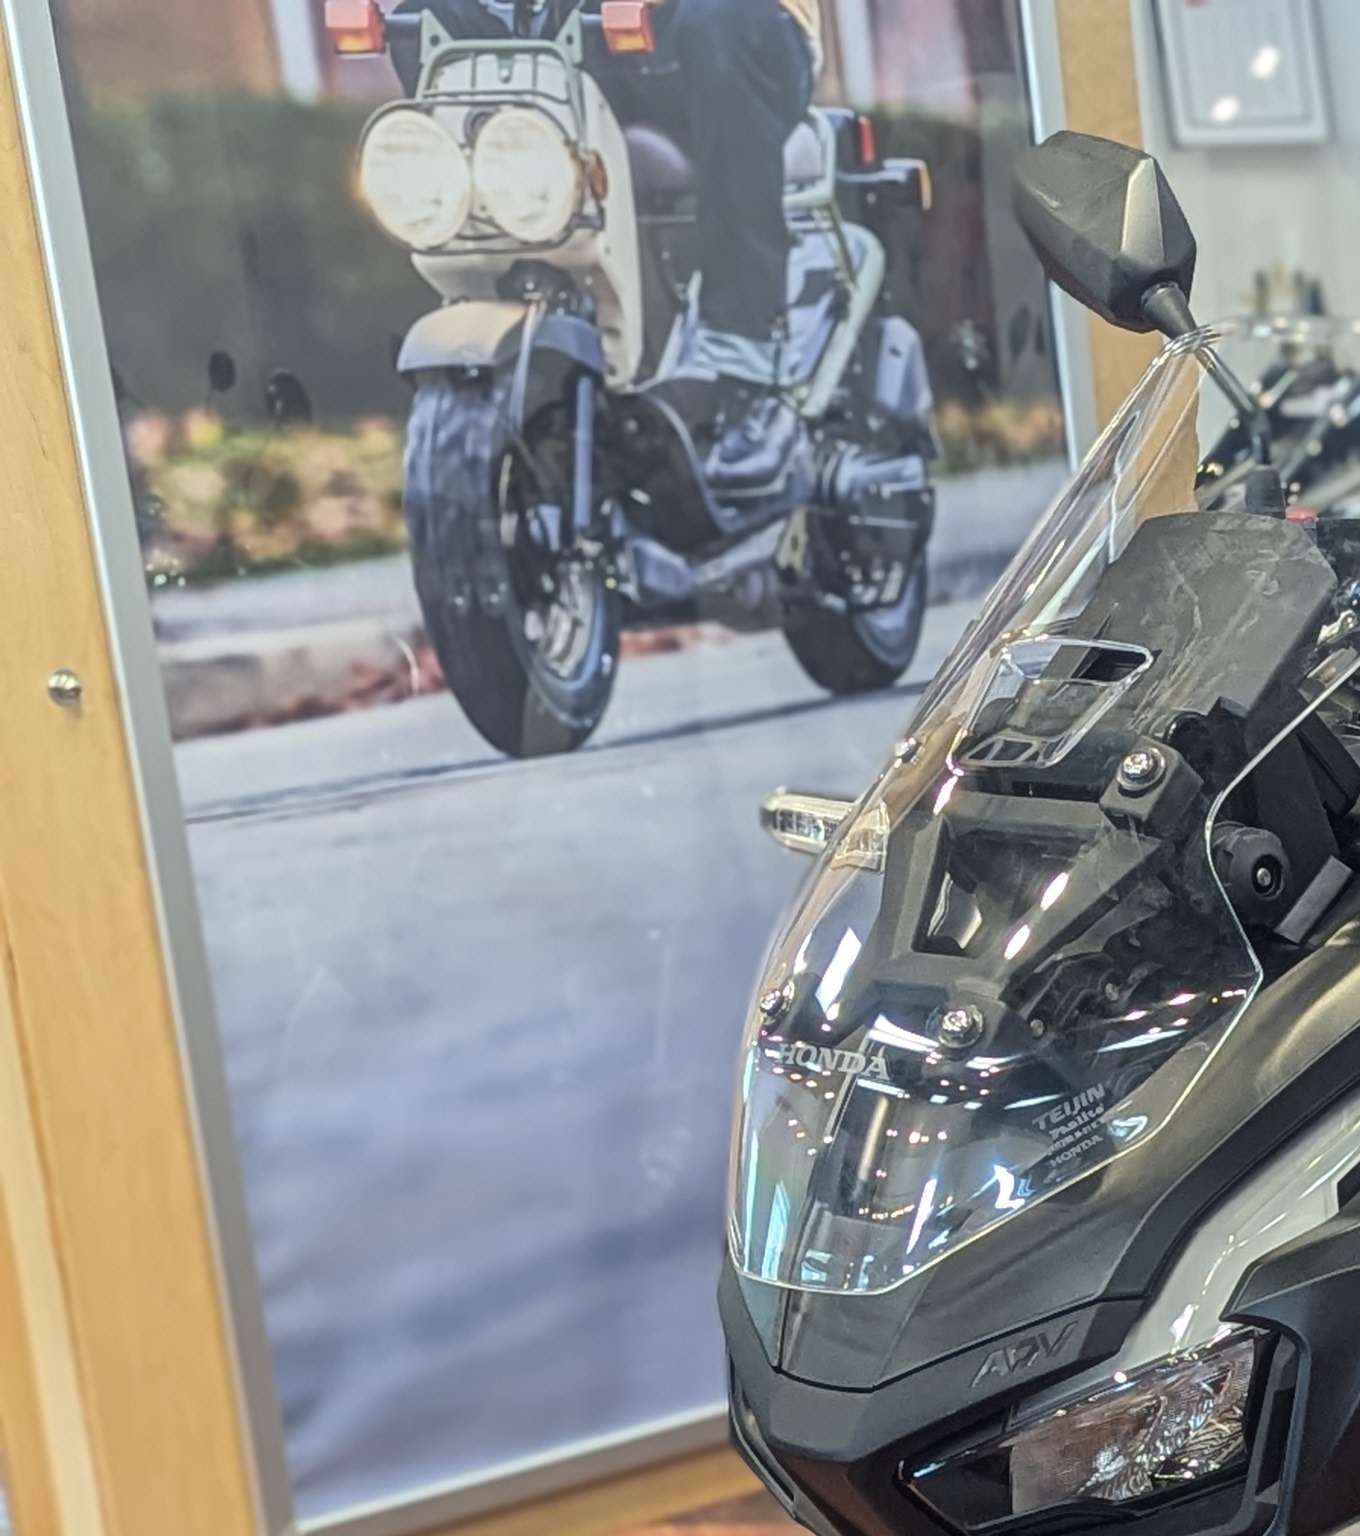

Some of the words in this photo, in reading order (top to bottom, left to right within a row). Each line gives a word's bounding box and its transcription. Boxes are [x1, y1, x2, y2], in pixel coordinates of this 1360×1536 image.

[779, 1043, 890, 1081] HONDA
[1031, 1083, 1106, 1130] TEIJIN
[1048, 1134, 1104, 1167] HONDA
[970, 1320, 1079, 1389] ADV
